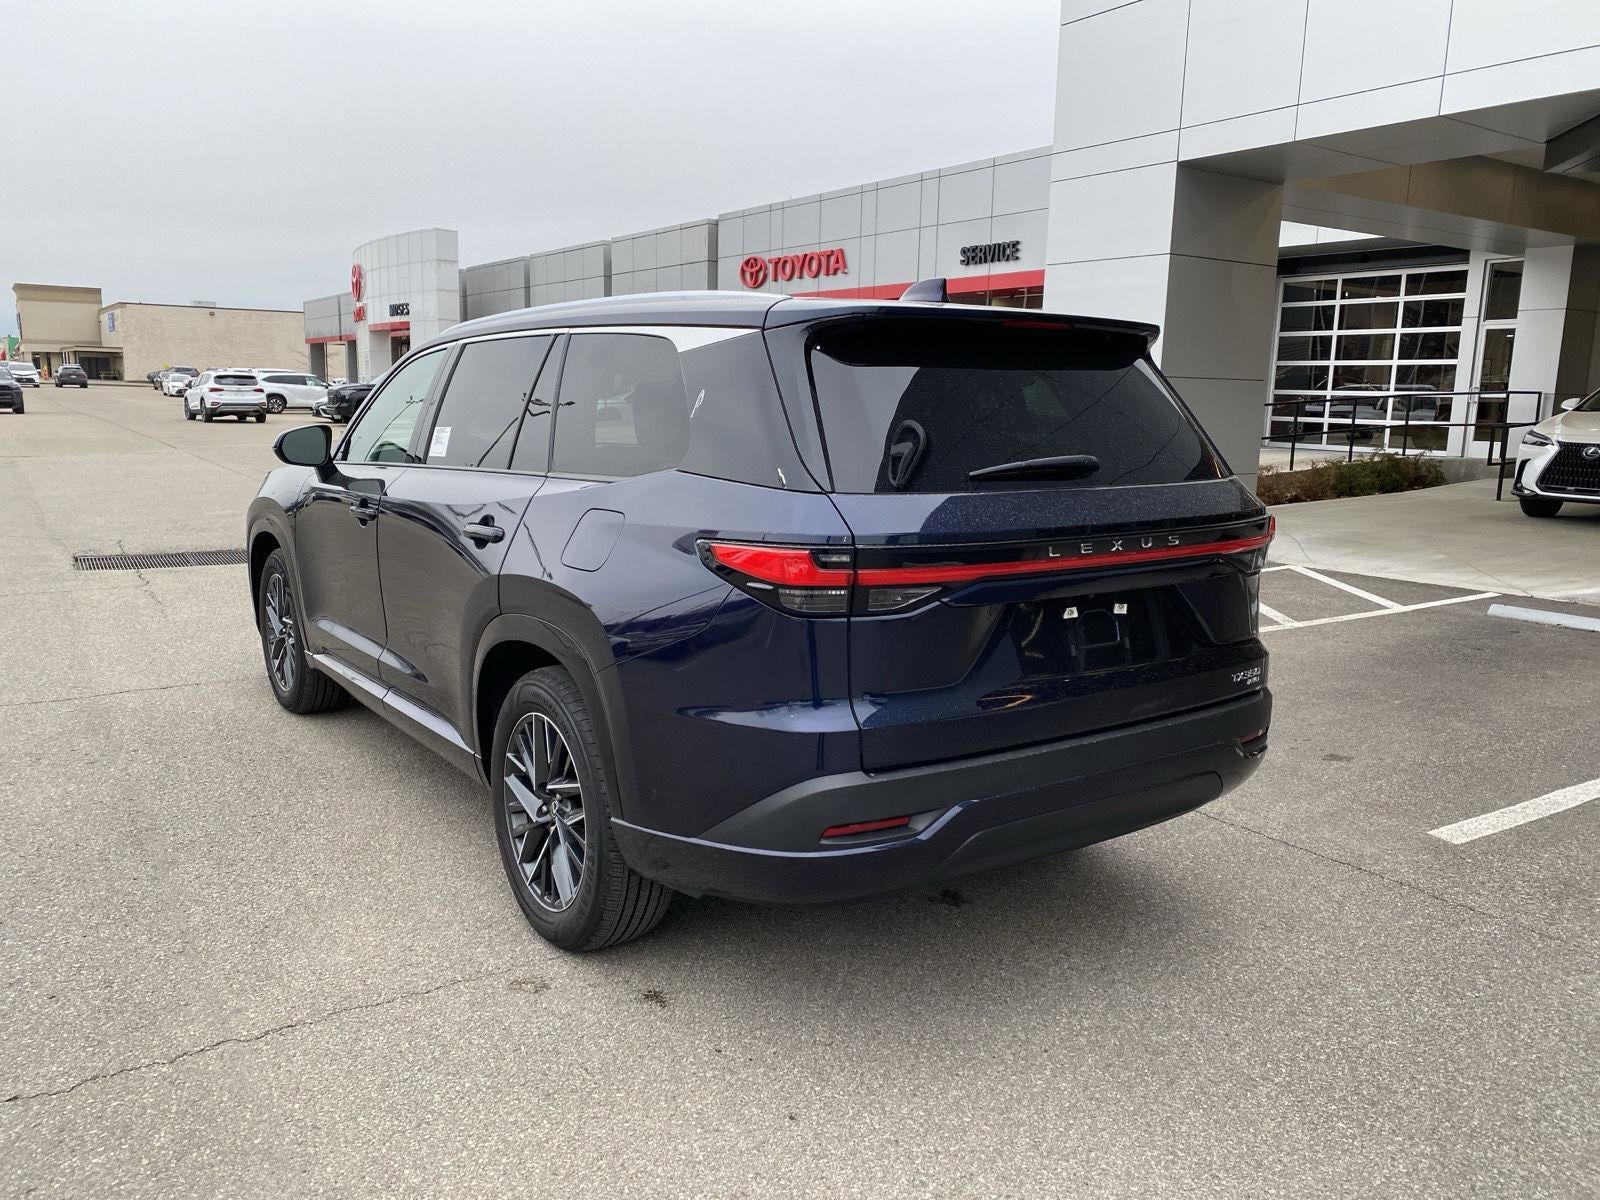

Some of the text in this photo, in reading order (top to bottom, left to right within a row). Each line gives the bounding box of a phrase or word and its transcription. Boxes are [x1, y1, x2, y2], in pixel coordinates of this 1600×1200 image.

[768, 247, 847, 282] TOYOTA
[959, 240, 1021, 266] SERVICE
[1048, 535, 1180, 557] LEXUS
